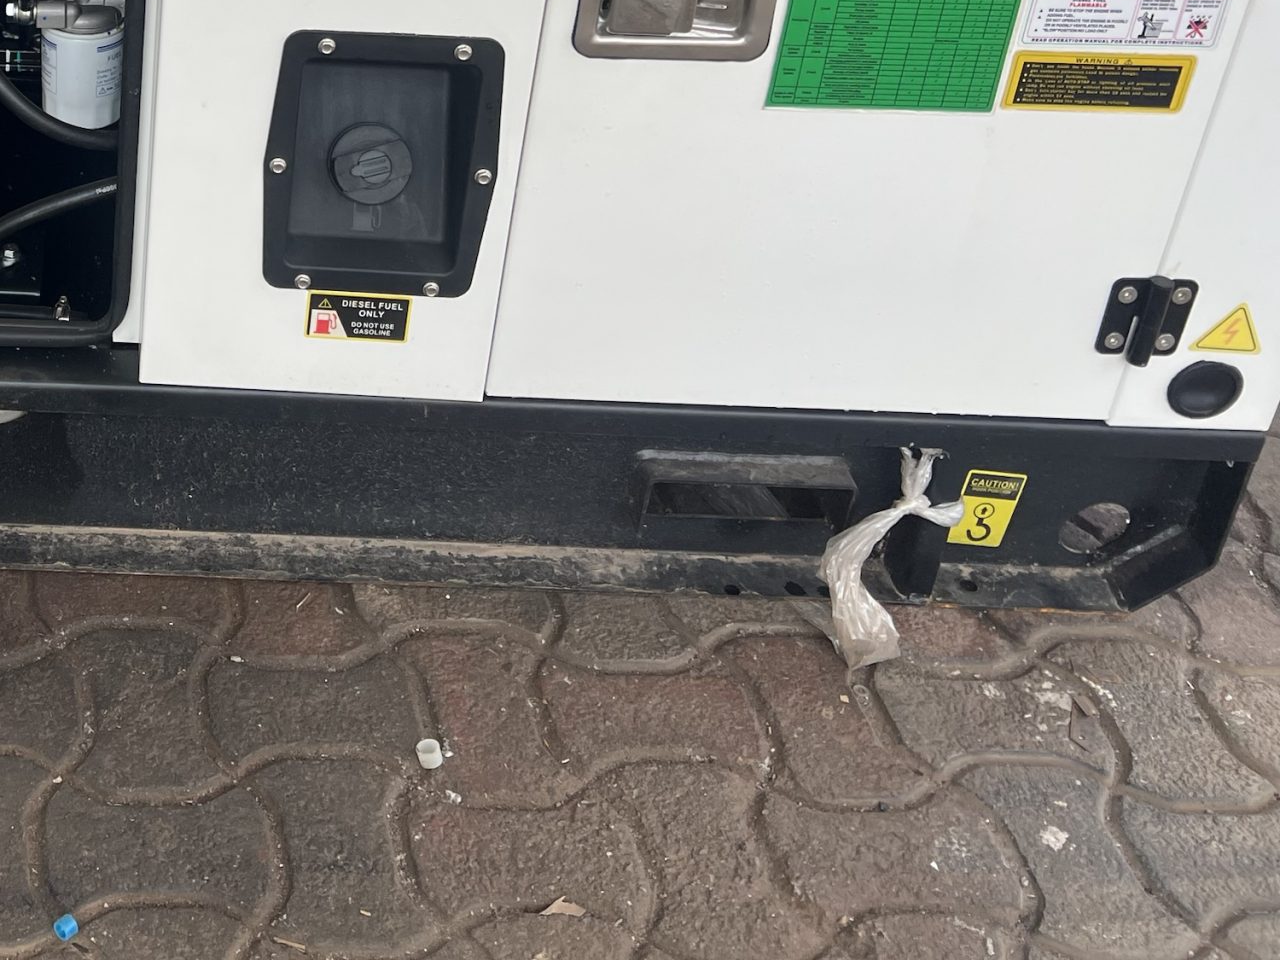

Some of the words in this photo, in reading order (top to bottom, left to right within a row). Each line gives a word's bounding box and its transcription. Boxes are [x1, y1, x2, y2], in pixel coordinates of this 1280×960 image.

[342, 300, 376, 309] DIESEL
[379, 302, 403, 311] FUEL
[359, 310, 385, 318] ONLY
[353, 328, 391, 336] GASOLINE
[971, 478, 1020, 490] CAUTION!
